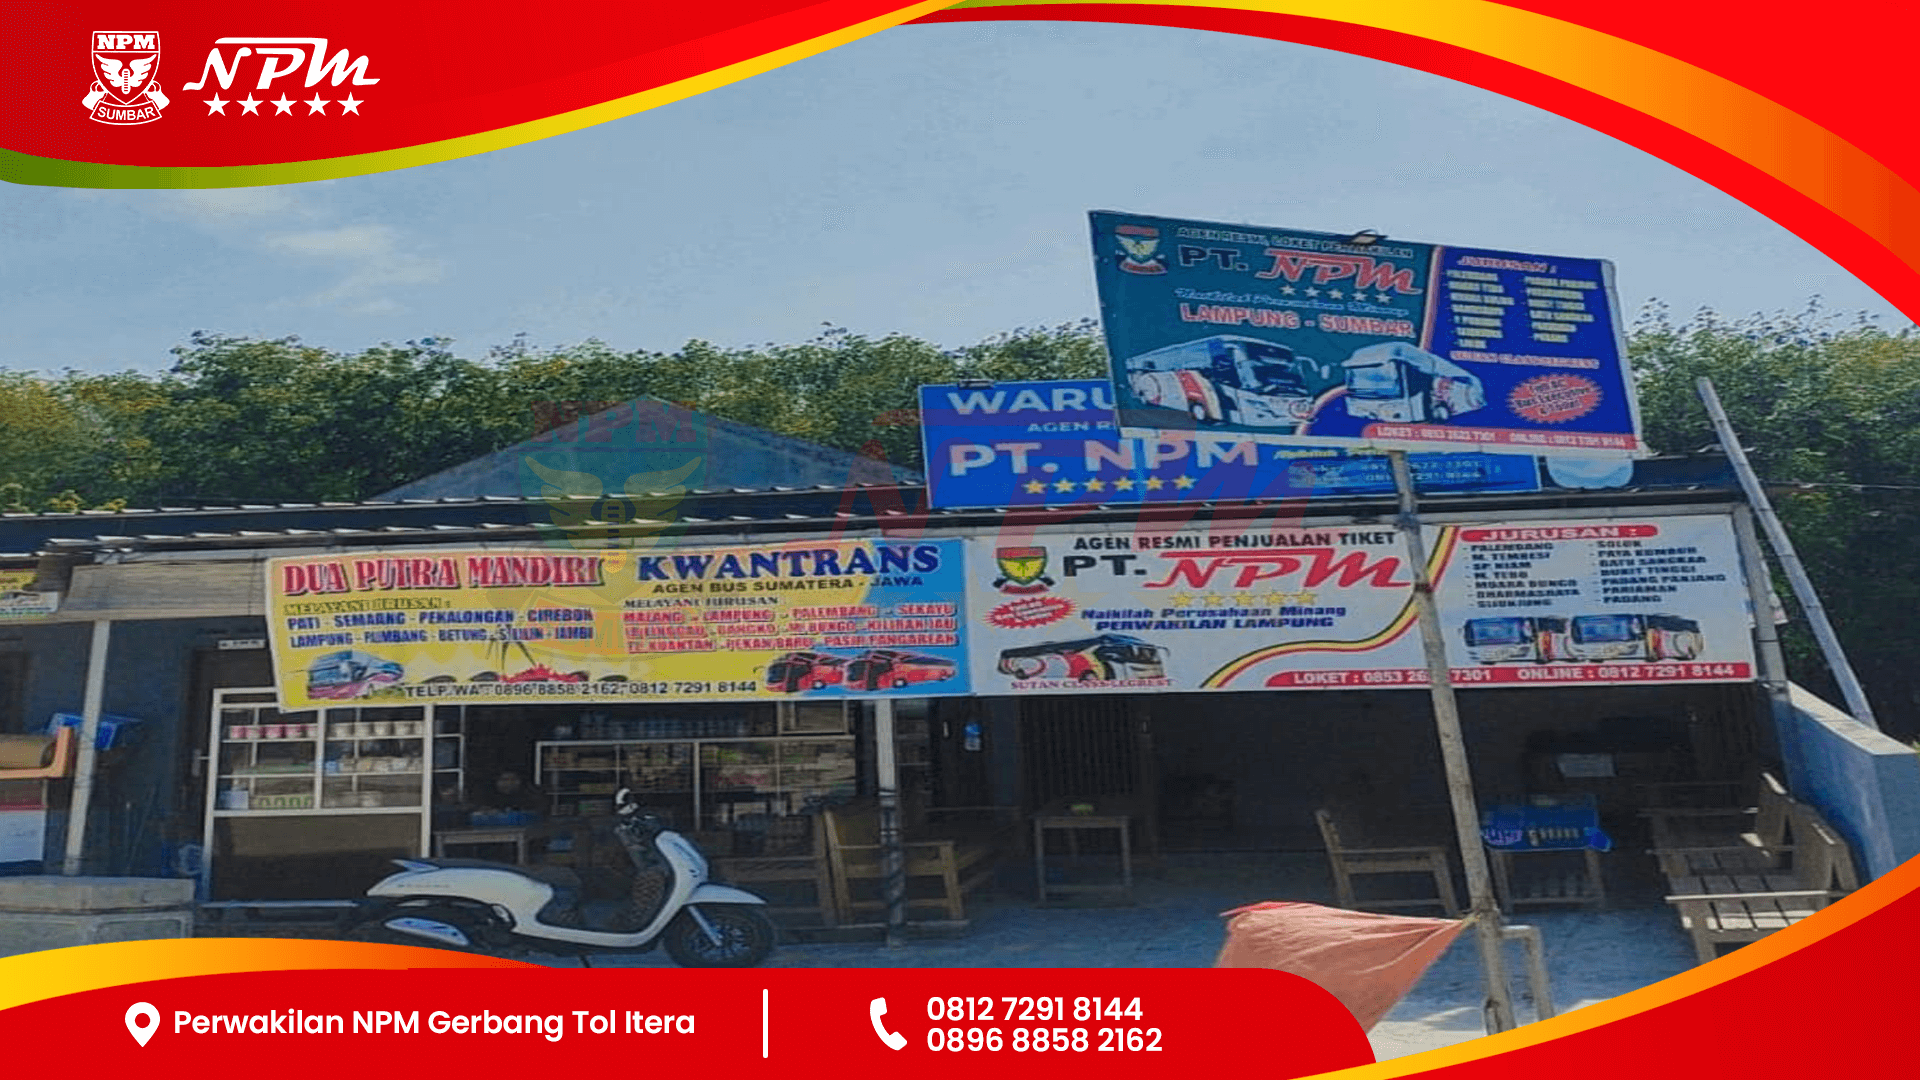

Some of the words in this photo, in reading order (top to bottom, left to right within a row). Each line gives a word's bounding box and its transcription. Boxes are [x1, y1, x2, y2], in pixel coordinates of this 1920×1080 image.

[1179, 244, 1250, 272] PT.
[1255, 248, 1423, 294] NPM
[1180, 303, 1300, 329] LAMPUNG
[1318, 314, 1416, 338] SUMBAR
[1027, 421, 1090, 432] AGEN
[950, 442, 1060, 476] PT.
[1084, 440, 1259, 471] NPM
[1074, 537, 1129, 550] AGEN
[1139, 535, 1199, 549] RESMI
[1209, 533, 1330, 548] PENJUALAN
[1338, 531, 1396, 545] TIKET
[1482, 527, 1619, 540] JURUSAN
[1471, 543, 1553, 551] PALEMBANG
[637, 545, 939, 581] KWANTRANS
[1063, 554, 1147, 577] PT.
[1143, 548, 1412, 589] NPM
[283, 563, 349, 595] DUA
[353, 558, 461, 590] PUTRA
[467, 556, 604, 587] MANDIRI
[653, 584, 703, 594] AGEN
[710, 582, 747, 592] BUS
[753, 579, 854, 592] SUMATERA
[870, 576, 924, 587] JAWA
[1602, 595, 1662, 603] PADANG
[288, 617, 320, 630] PATI
[334, 612, 405, 628] SEMARANG
[419, 610, 514, 624] PEKALONGAN
[527, 608, 593, 622] CIREBON
[623, 612, 686, 624] MALANG
[703, 609, 775, 622] LAMPUNG
[791, 606, 877, 619] PALEMBANG
[898, 603, 956, 617] SEKAYU
[1278, 606, 1346, 618] Minang
[1095, 619, 1227, 631] PERWAKILAN
[1233, 617, 1334, 629] LAMPUNG
[290, 632, 353, 648] LAMPUNG
[438, 629, 488, 641] BETUNG
[555, 626, 593, 639] JAMBI
[1294, 672, 1348, 684] LOKET
[1363, 671, 1404, 683] 0853
[1451, 669, 1491, 682] 7301
[1517, 668, 1583, 680] ONLINE
[1597, 667, 1641, 679] 0812
[1646, 665, 1686, 678] 7291
[1691, 664, 1735, 677] 8144
[494, 682, 533, 695] 0896
[538, 682, 575, 694] 8858
[632, 682, 668, 694] 0812
[675, 681, 711, 693] 7291
[718, 680, 757, 693] 8144
